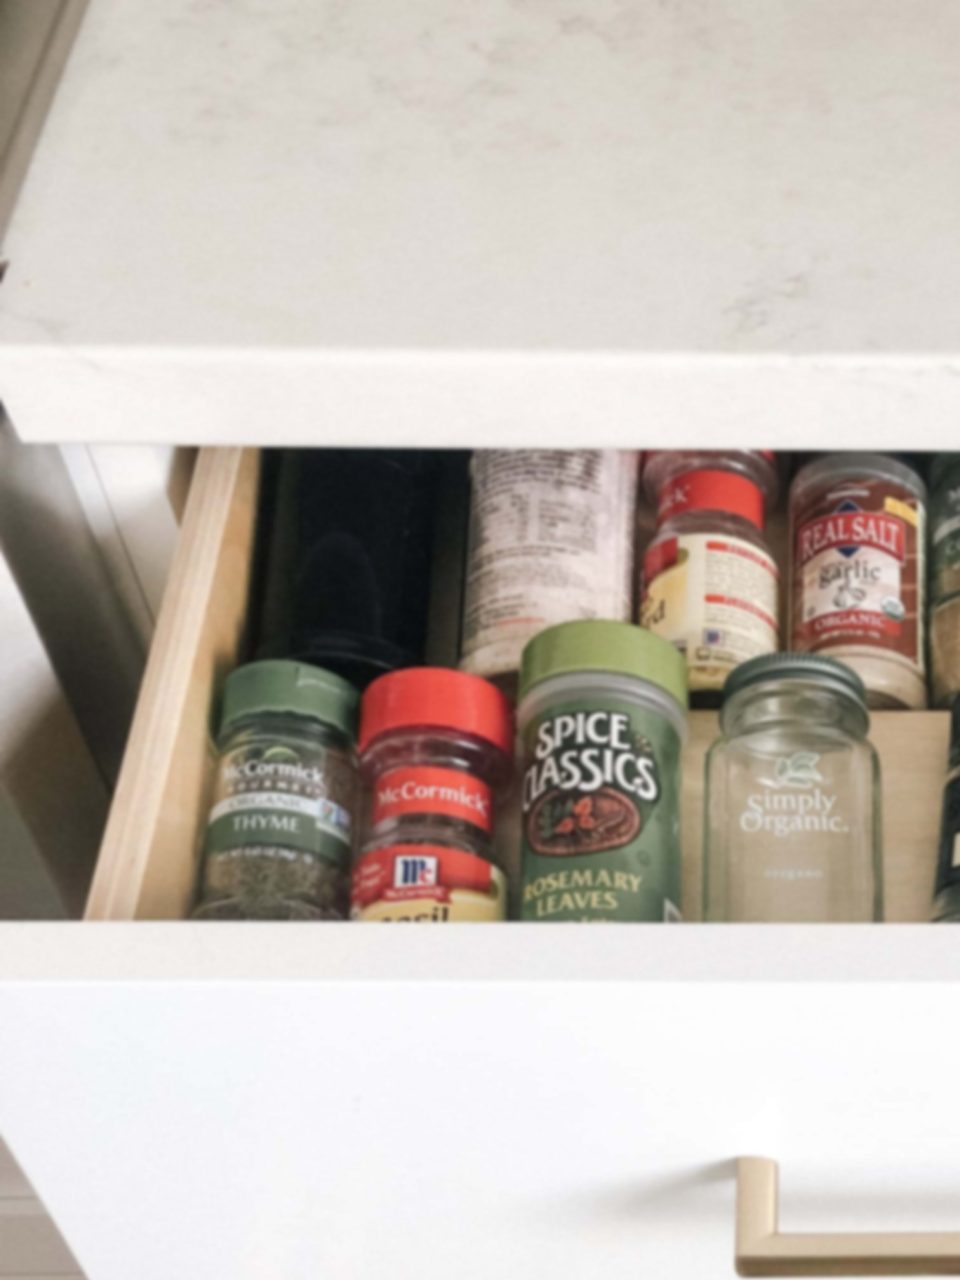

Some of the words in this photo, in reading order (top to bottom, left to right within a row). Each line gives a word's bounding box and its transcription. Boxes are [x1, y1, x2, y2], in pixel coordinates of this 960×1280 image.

[802, 518, 849, 558] REAL
[852, 516, 899, 551] SALT
[818, 561, 881, 588] garlic
[815, 612, 886, 631] ORGANIC
[536, 712, 631, 759] SPICE
[223, 759, 324, 783] McCormick
[378, 780, 488, 818] McCormick
[747, 788, 838, 815] Simply
[233, 813, 301, 832] THYME
[523, 869, 643, 901] ROSEMARY
[536, 891, 620, 918] LEAVES
